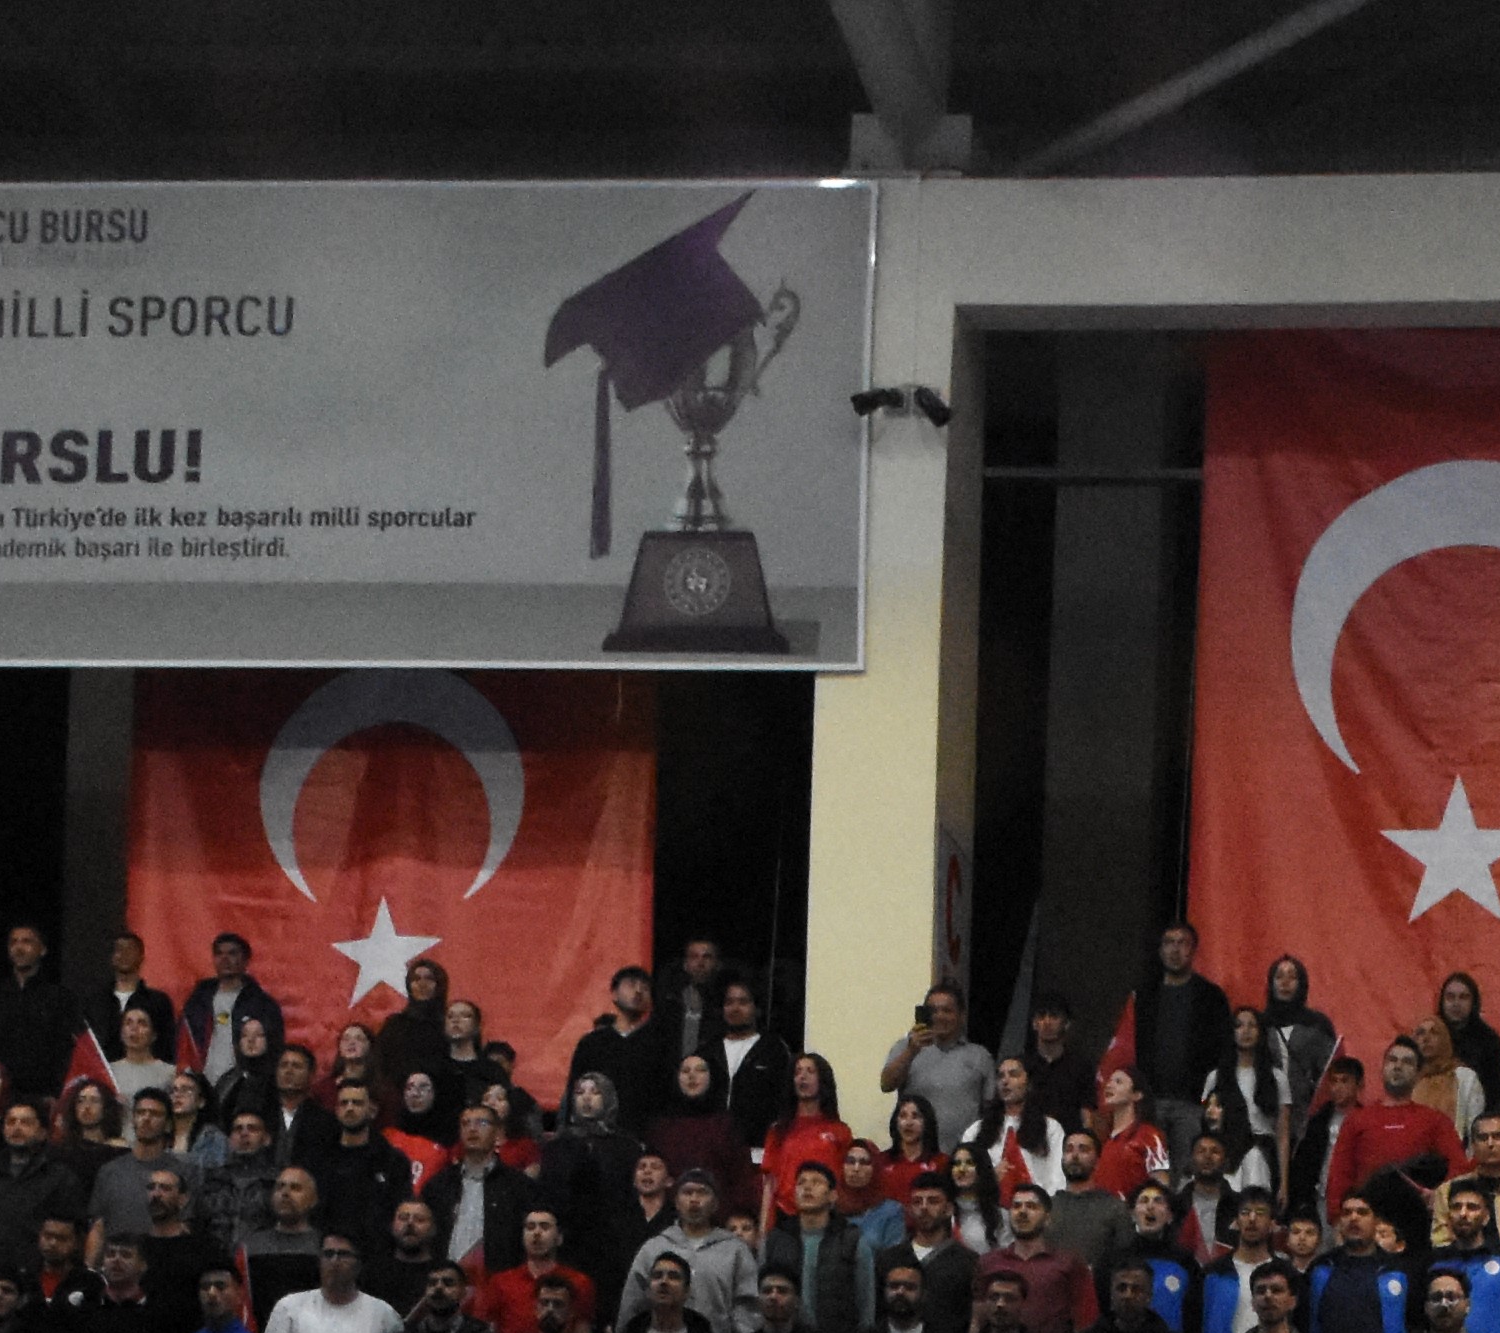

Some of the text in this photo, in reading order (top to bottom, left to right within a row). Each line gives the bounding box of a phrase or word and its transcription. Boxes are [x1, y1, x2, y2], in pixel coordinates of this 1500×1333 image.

[39, 208, 149, 245] BURSU
[108, 295, 296, 338] SPORCU
[133, 506, 162, 529] ilk
[169, 506, 208, 529] kez
[215, 505, 301, 533] başarılı
[309, 505, 360, 529] milli
[367, 506, 477, 534] sporcular
[74, 537, 142, 562] başarı
[147, 536, 173, 560] ile
[180, 535, 290, 562] birleştirdi.
